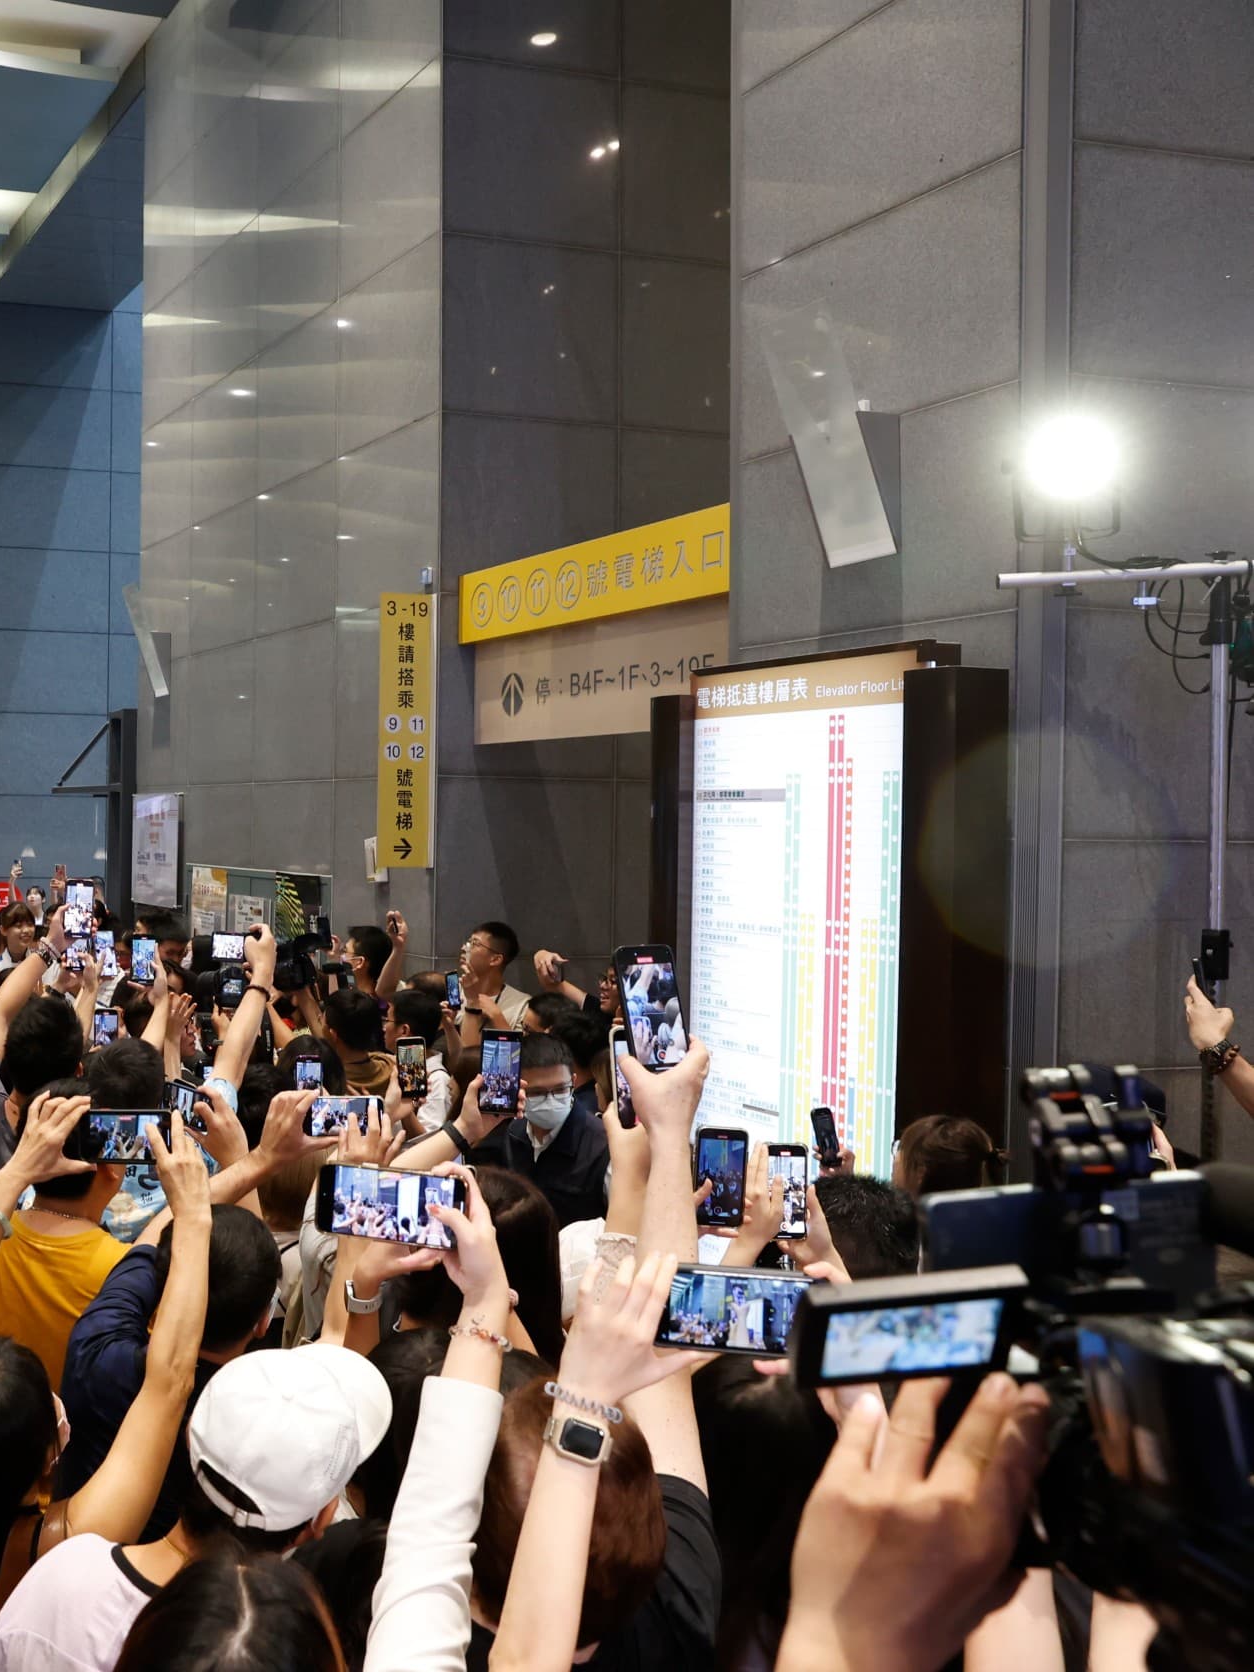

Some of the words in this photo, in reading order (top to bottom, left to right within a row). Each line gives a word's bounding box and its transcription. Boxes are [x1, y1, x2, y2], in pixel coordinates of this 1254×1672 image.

[586, 530, 725, 598] 號電梯入口
[398, 622, 415, 709] 樓請搭乘
[697, 677, 809, 710] 電梯抵達樓層表
[815, 684, 858, 698] Elevator
[860, 680, 889, 694] Floor
[388, 717, 398, 731] 9
[411, 718, 424, 732] 11
[386, 745, 401, 759] 10
[410, 745, 424, 759] 12
[396, 768, 414, 831] 號電梯
